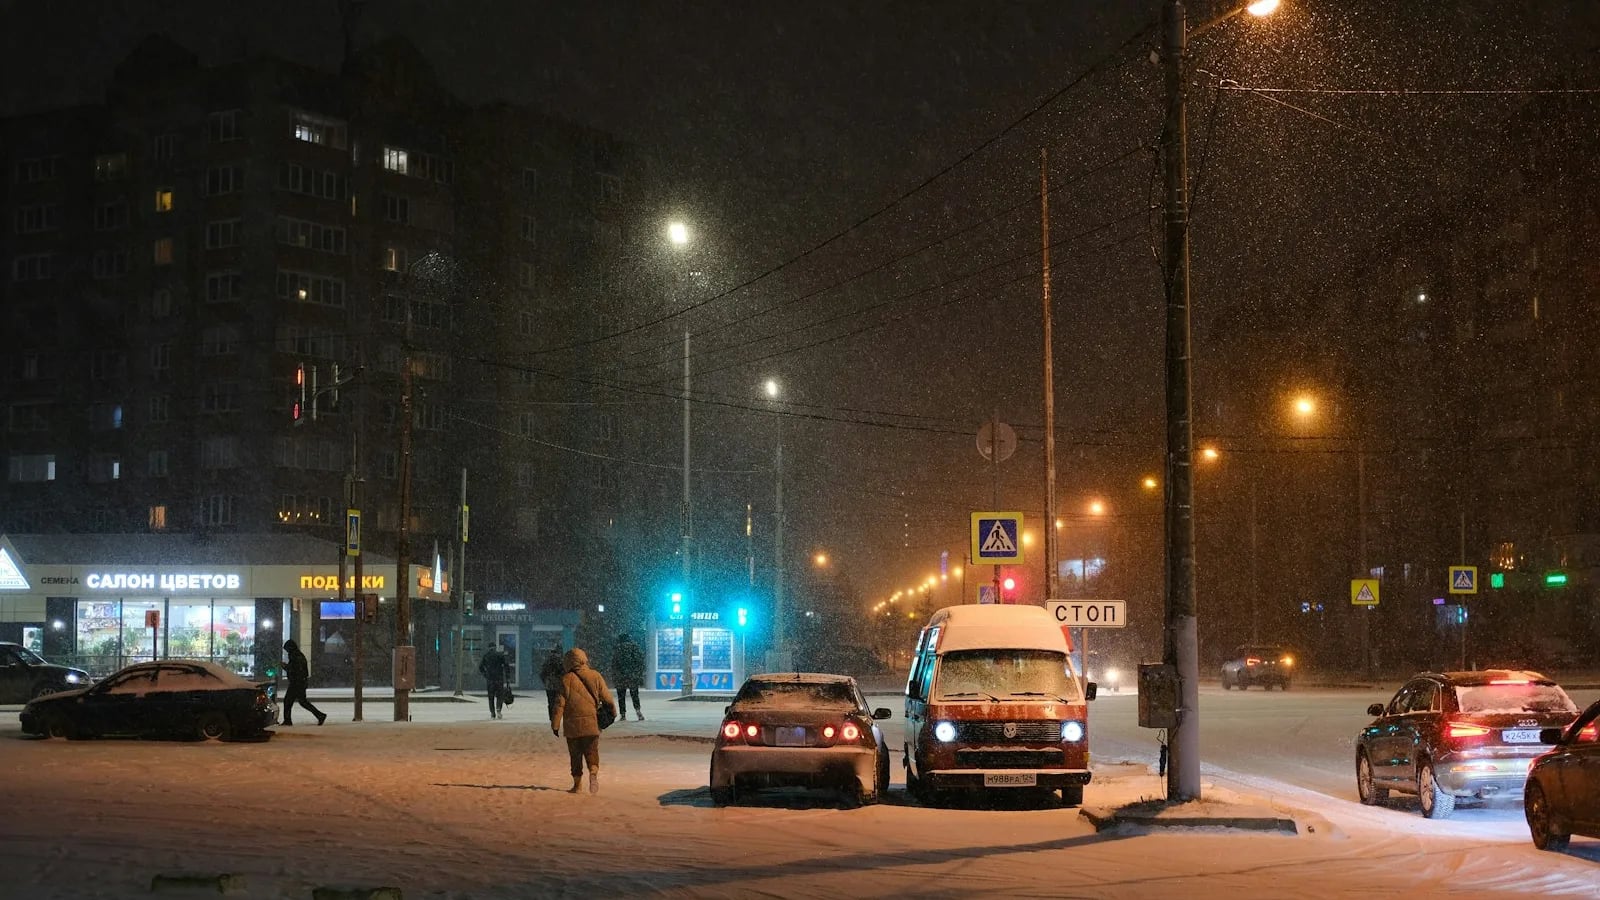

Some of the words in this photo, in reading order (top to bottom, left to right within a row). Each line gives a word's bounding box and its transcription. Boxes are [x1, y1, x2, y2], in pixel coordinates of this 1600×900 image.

[40, 577, 79, 585] СЕМЕНА
[87, 574, 155, 588] САЛОН
[161, 574, 240, 591] ЦВЕТОВ
[300, 575, 384, 590] ПОДКИ
[1055, 605, 1115, 622] СТОП
